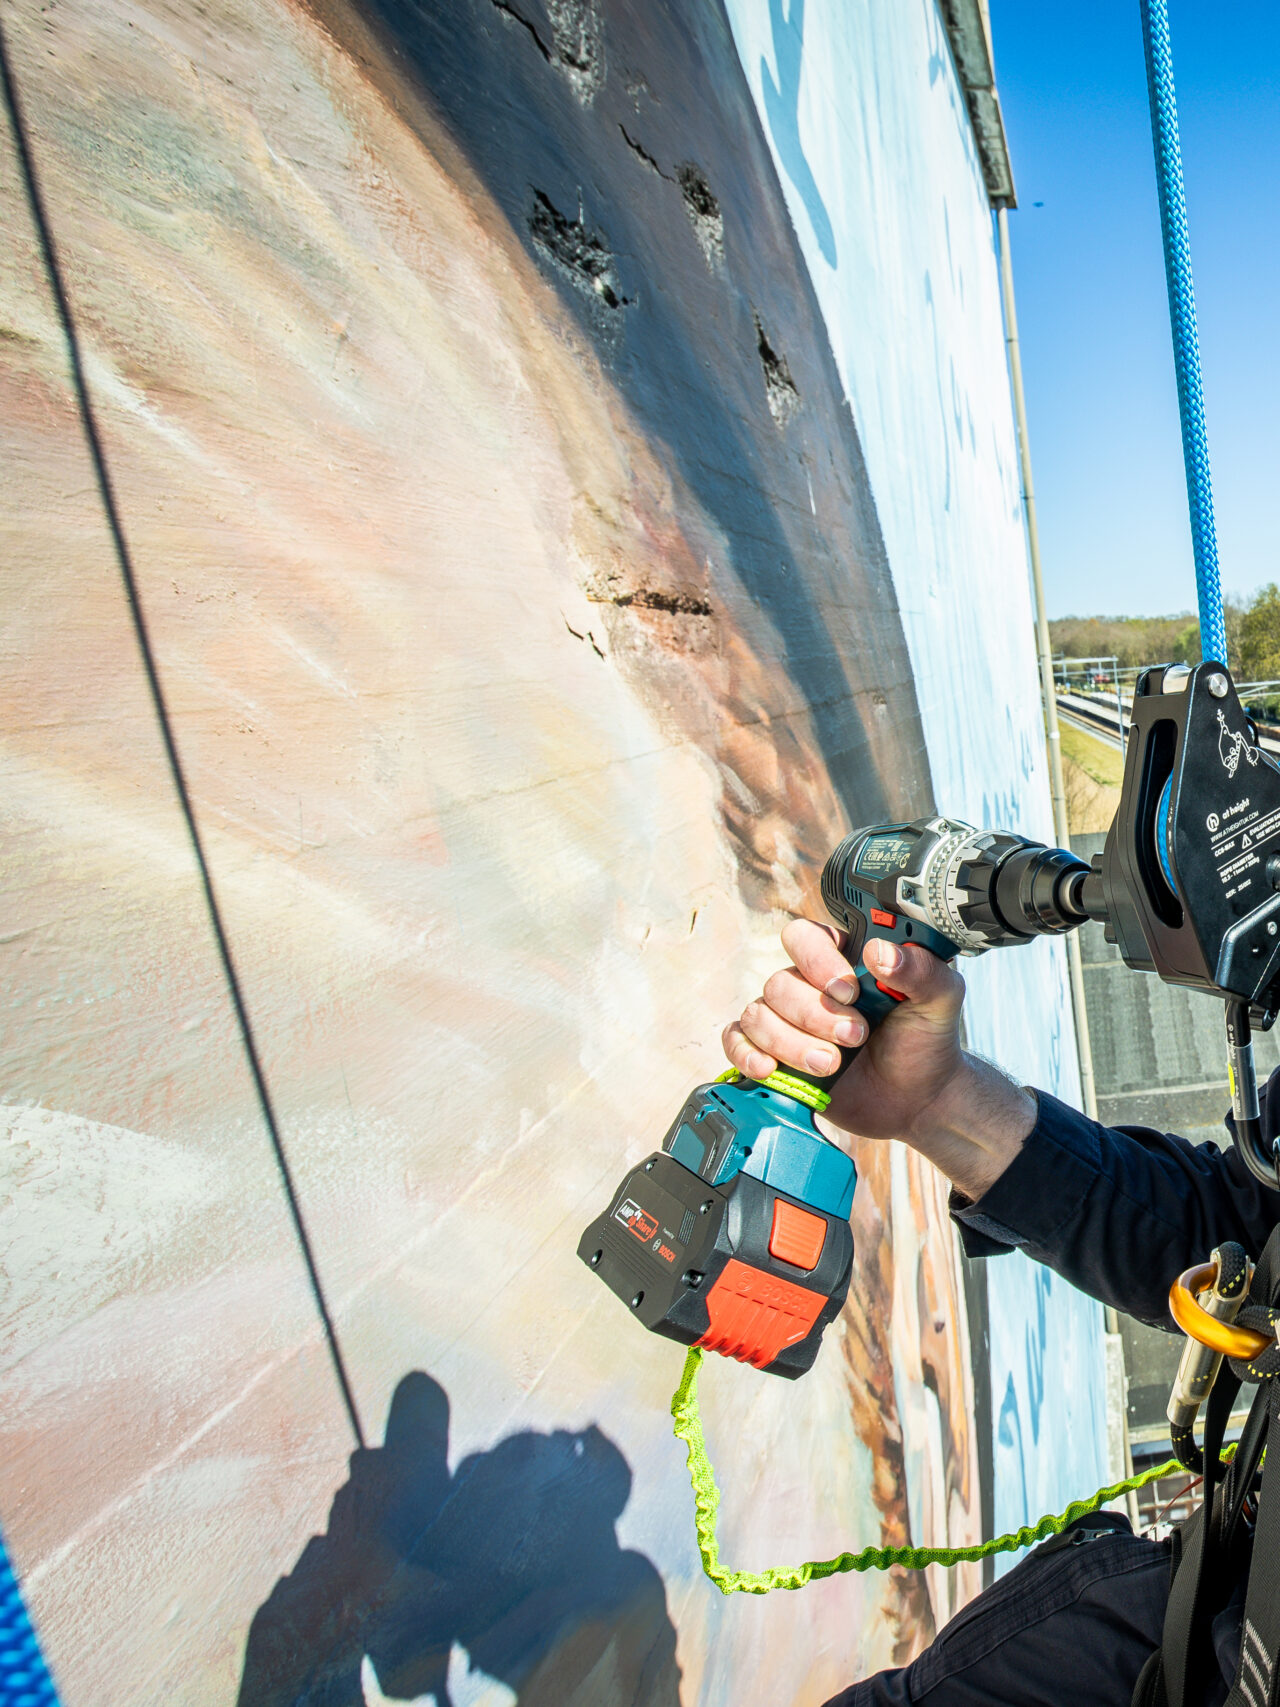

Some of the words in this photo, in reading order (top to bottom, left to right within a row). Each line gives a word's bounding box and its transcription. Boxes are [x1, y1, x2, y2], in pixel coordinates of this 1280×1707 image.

[1229, 797, 1250, 814] height
[954, 917, 965, 929] 10
[620, 1204, 635, 1219] AMP
[658, 1244, 677, 1263] BOSCH
